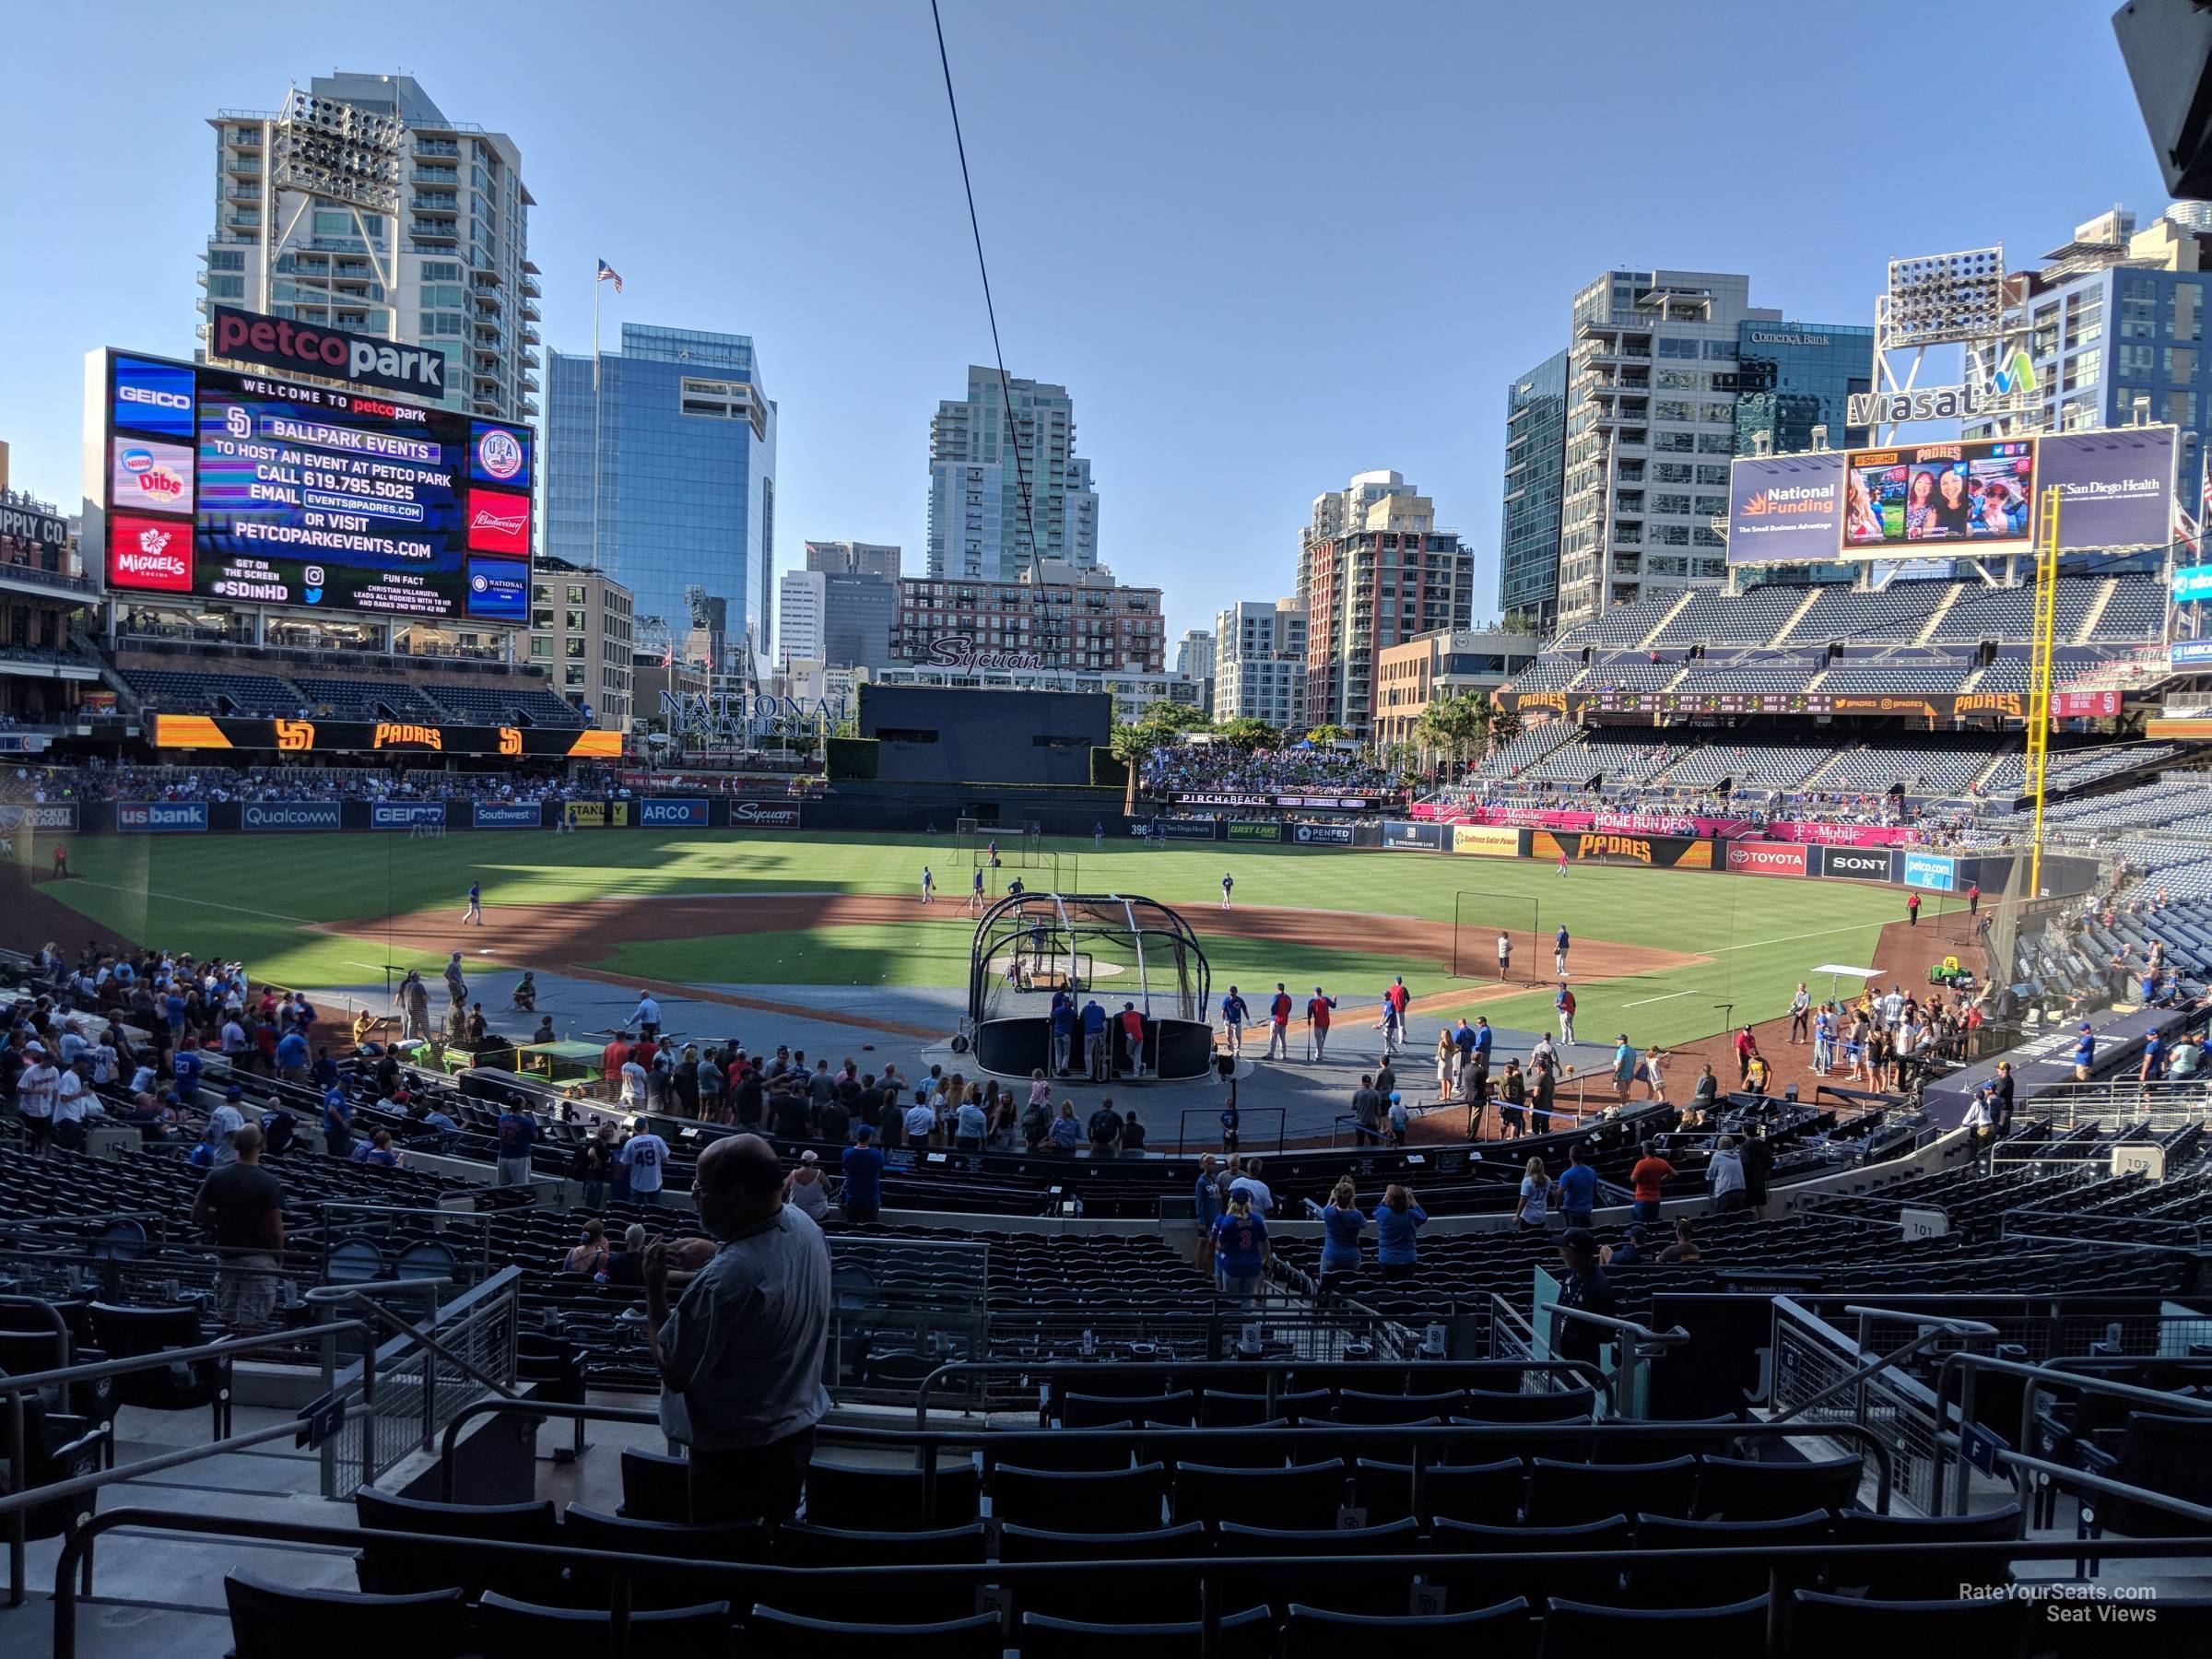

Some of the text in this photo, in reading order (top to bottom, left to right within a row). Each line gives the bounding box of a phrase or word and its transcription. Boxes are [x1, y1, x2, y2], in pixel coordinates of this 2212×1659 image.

[1804, 335, 1830, 346] Bank
[120, 385, 191, 410] GEICO
[243, 379, 321, 404] WELCOME
[329, 394, 347, 408] TO
[1852, 383, 1980, 425] Viasat
[273, 420, 429, 459] BALLPARK EVENTS
[1916, 446, 1962, 464] PADRES
[215, 440, 452, 488] TO HOST AN EVENT AT PETCO PARK
[139, 472, 182, 496] Dibs
[256, 464, 415, 500] CALL 619.795.5025
[2066, 483, 2088, 495] San
[2088, 481, 2122, 495] Diego
[2123, 478, 2160, 491] Health
[250, 484, 420, 517] EMAIL EVENTS@PADRES.COM
[1768, 484, 1835, 501] National
[1768, 500, 1834, 514] Funding
[0, 509, 66, 547] PPLY CO.
[305, 512, 370, 533] OR VISIT
[478, 515, 521, 529] Budweiser
[235, 522, 431, 559] PETCOPARKEVENTS.COM
[236, 559, 269, 570] GET ON
[224, 568, 280, 581] THE SCREEN
[382, 573, 425, 586] FUN FACT
[368, 585, 439, 598] CHRISTIAN VILLANUEVA
[489, 580, 524, 589] NATIONAL
[354, 591, 375, 599] LEADS
[389, 594, 417, 603] ROOKIES
[418, 596, 433, 605] WITH
[373, 600, 395, 609] RANKS
[396, 601, 409, 610] 2ND
[410, 603, 426, 612] WITH
[927, 635, 1044, 678] Sycuan
[659, 690, 855, 722] NATIONAL
[1517, 692, 1567, 712] PADRES
[1847, 700, 1877, 708] @PADRES
[1953, 694, 2022, 716] PADRES
[675, 715, 839, 737] UNIVERSITY
[373, 723, 442, 750] PADRES
[1182, 794, 1222, 804] PIRCH
[1231, 795, 1265, 805] BEACH
[25, 807, 72, 818] ROCKET
[478, 809, 530, 820] Southwest
[570, 806, 623, 815] STANLY
[643, 806, 689, 819] ARCO
[732, 803, 793, 827] Sycuan
[26, 816, 72, 827] LEAGUE
[1594, 813, 1631, 829] HOME
[1633, 815, 1660, 830] RUN
[1312, 829, 1349, 838] PENFED
[1577, 833, 1652, 863] PADRES
[1749, 853, 1804, 865] TOYOTA
[1832, 856, 1887, 871] SONY
[1909, 859, 1950, 875] petco.com
[175, 1061, 190, 1074] 23
[635, 1149, 656, 1167] 49
[1912, 1222, 1934, 1237] 101
[1239, 1229, 1253, 1250] 3
[325, 1414, 334, 1432] F
[1972, 1441, 1982, 1457] F
